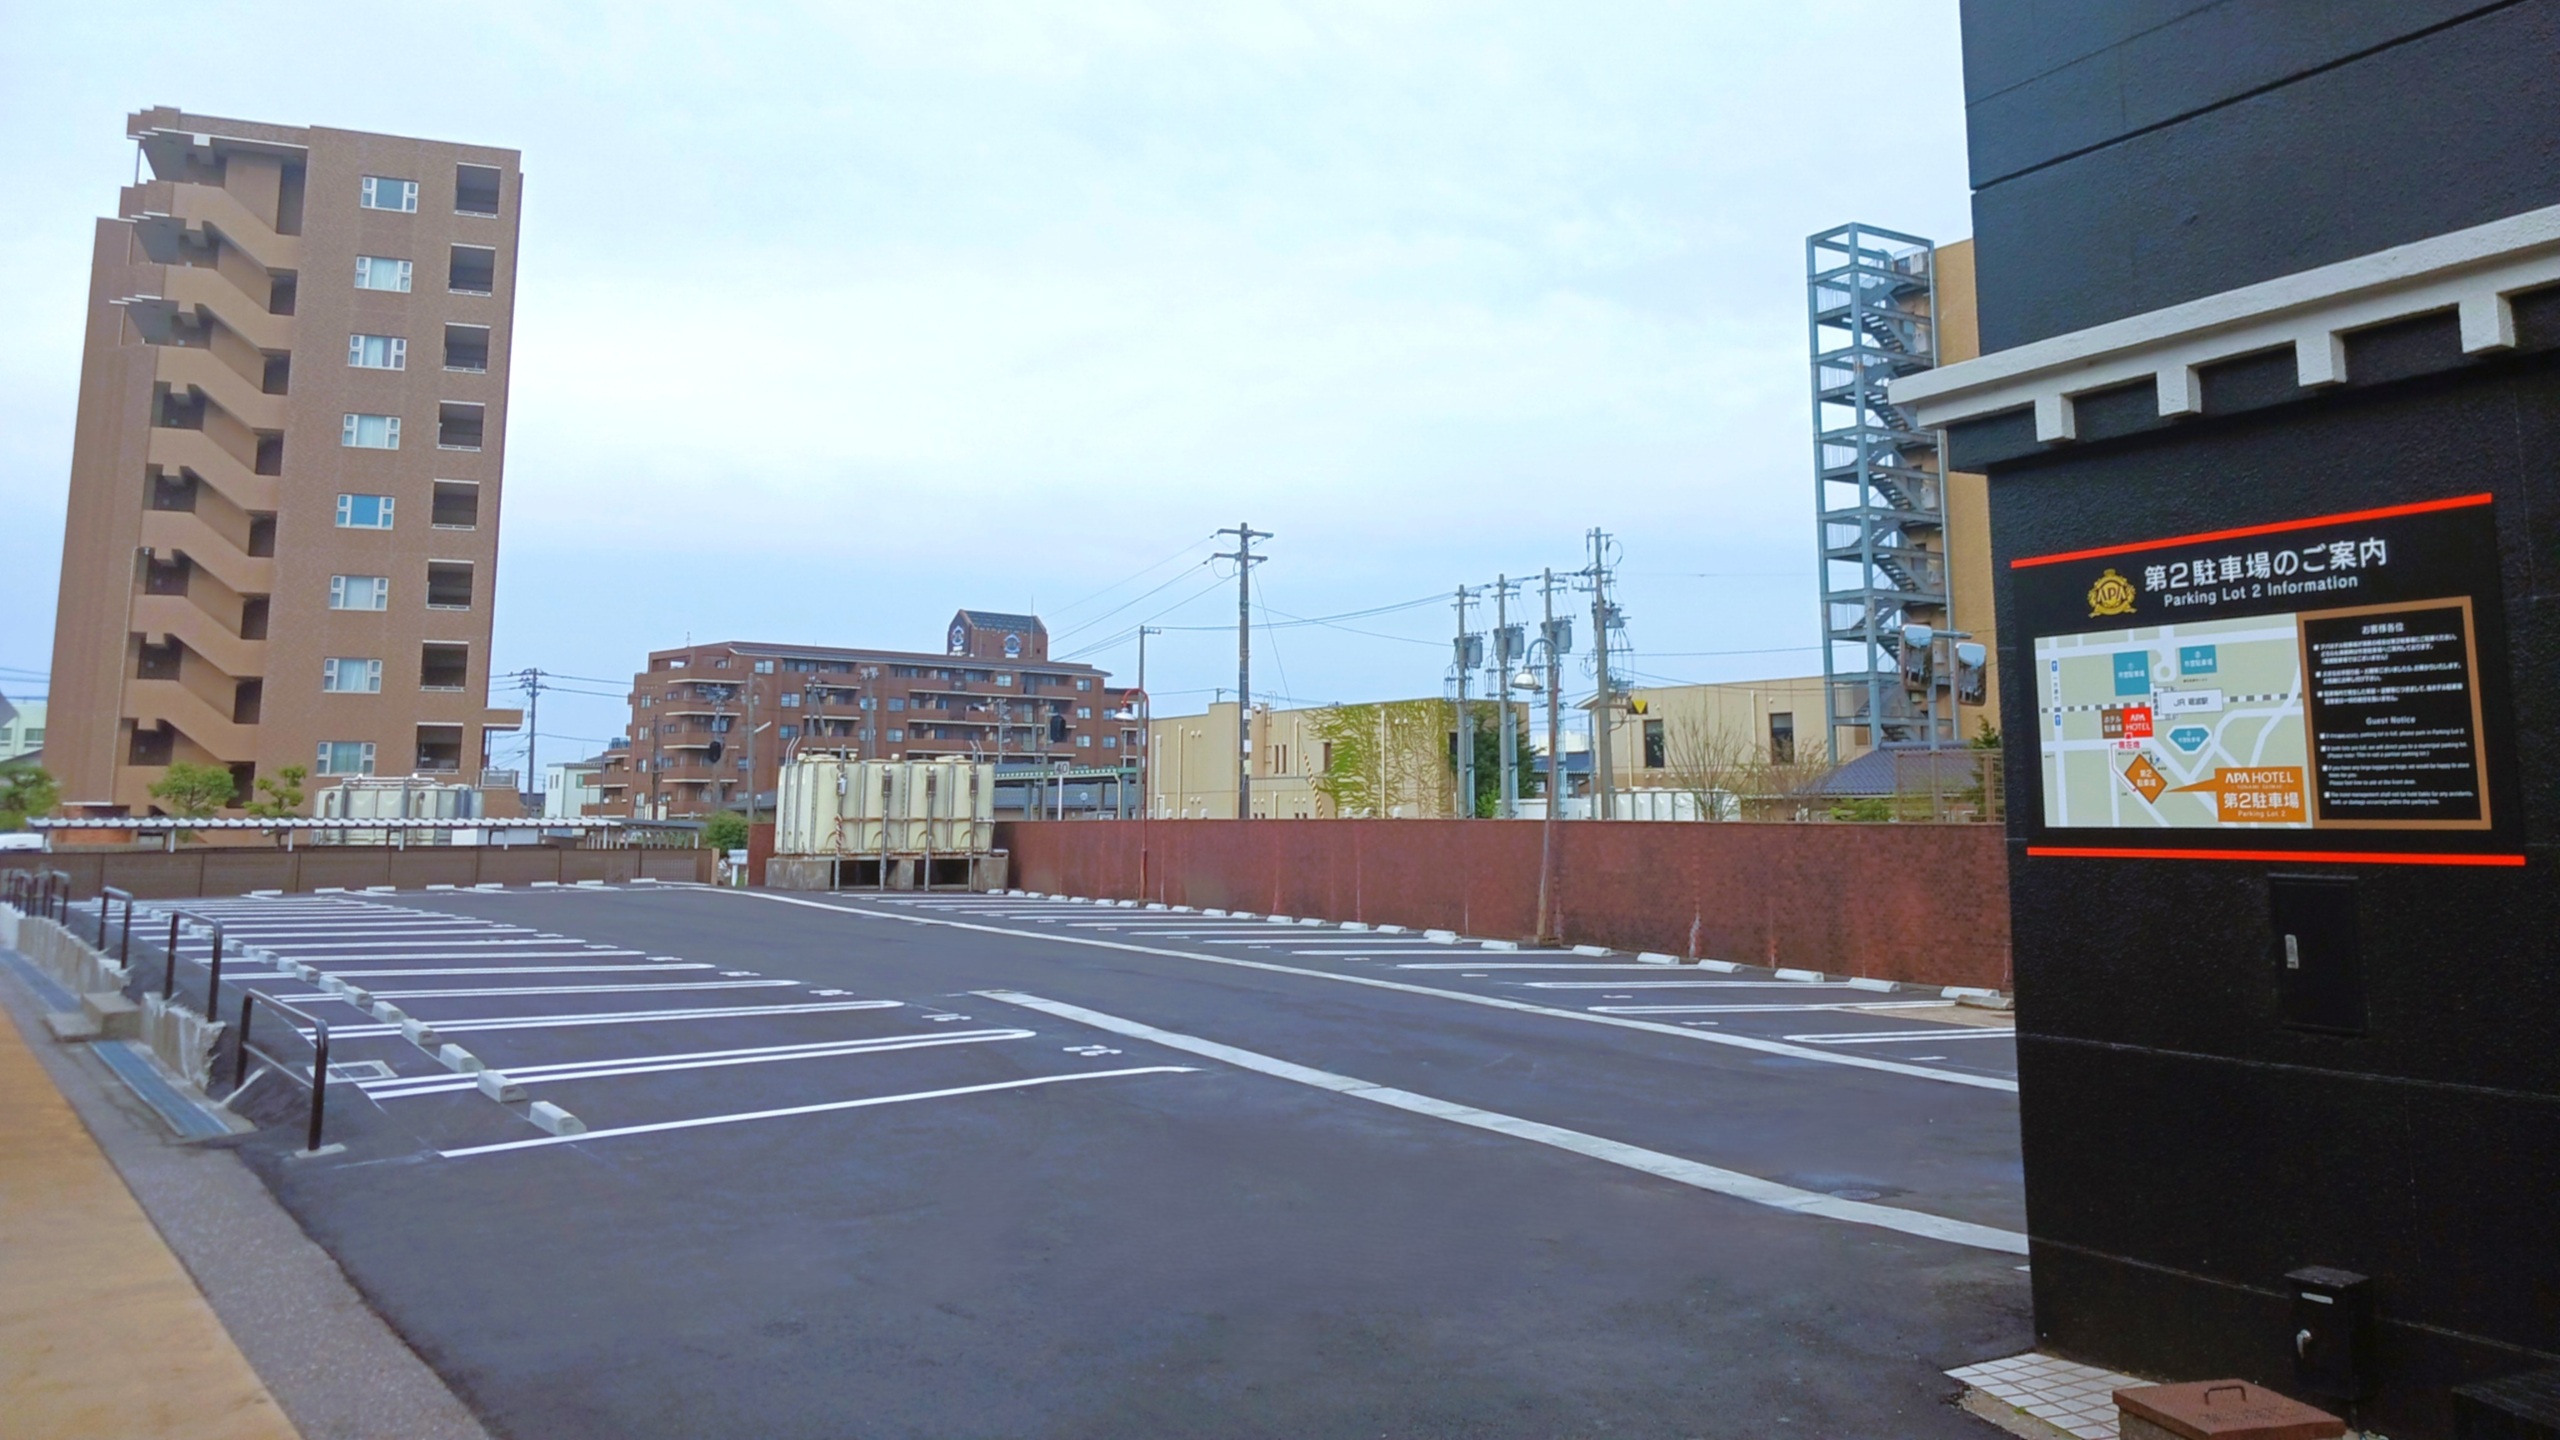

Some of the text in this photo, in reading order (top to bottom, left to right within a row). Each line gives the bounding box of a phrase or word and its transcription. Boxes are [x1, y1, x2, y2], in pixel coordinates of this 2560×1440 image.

[2144, 536, 2387, 592] 第2駐車場のご案内
[2164, 575, 2359, 608] Parking Lot 2 Information
[2361, 622, 2405, 635] お客様各位
[2125, 722, 2151, 731] HOTEL
[2365, 715, 2416, 726] Guest Notice
[1056, 762, 1068, 774] 40
[2225, 771, 2294, 784] APA HOTEL
[2224, 792, 2299, 809] 第2駐車場
[2238, 810, 2265, 818] Parking
